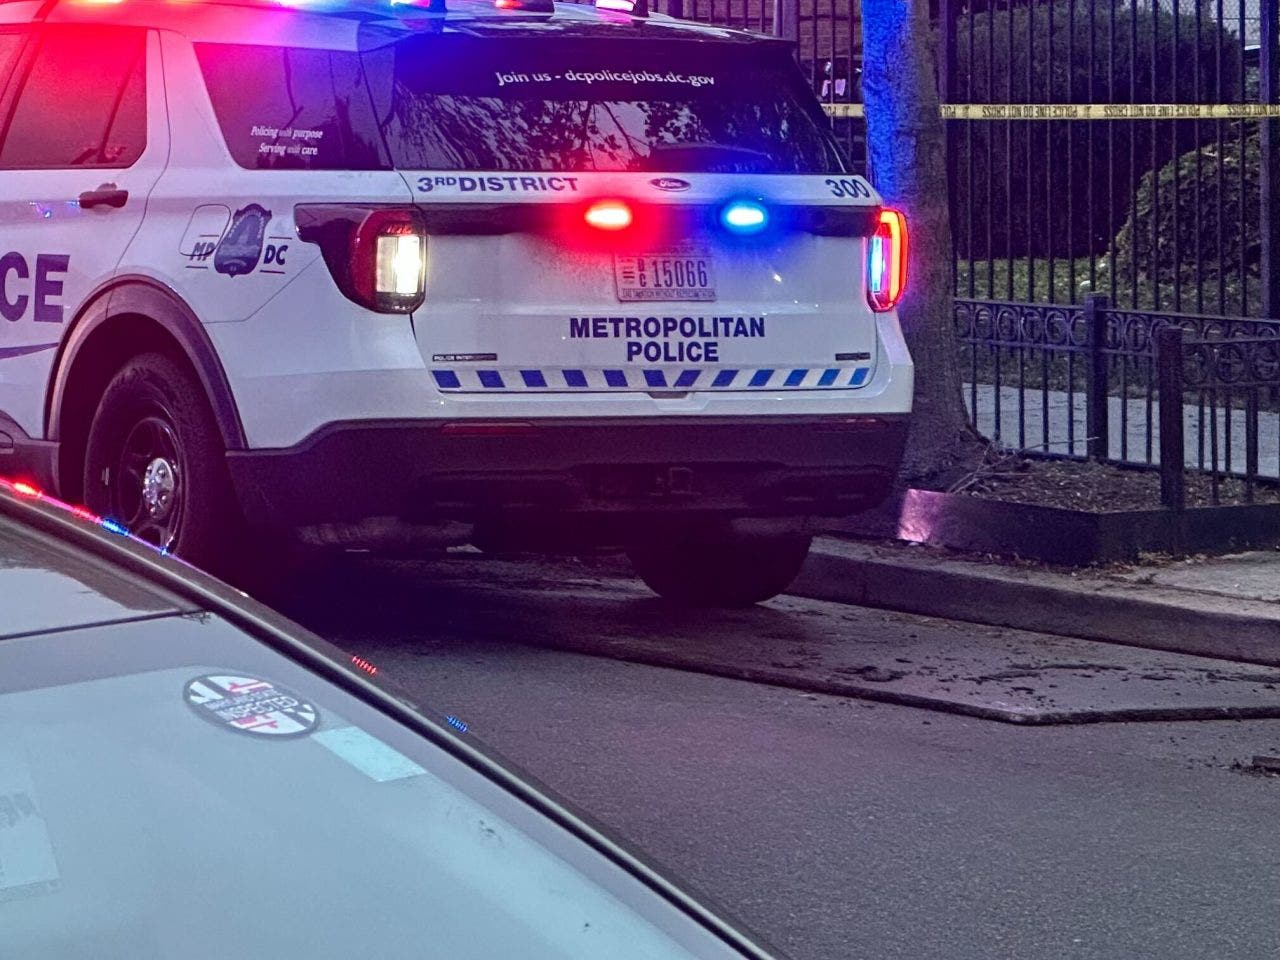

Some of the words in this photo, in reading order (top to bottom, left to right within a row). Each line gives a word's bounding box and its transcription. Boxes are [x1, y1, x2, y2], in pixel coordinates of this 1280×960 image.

[495, 70, 529, 86] Join
[533, 73, 551, 82] us
[564, 69, 715, 87] dcpolicejobs.dc.gov
[250, 126, 279, 139] Policing
[292, 129, 323, 140] purpose
[259, 142, 286, 156] Serving
[301, 146, 318, 155] care
[417, 176, 457, 193] 3RD
[458, 176, 578, 192] DISTRICT
[825, 179, 870, 198] 300
[263, 244, 289, 266] DC
[651, 259, 708, 288] 15066
[569, 316, 766, 339] METROPOLITAN
[626, 341, 719, 363] POLICE
